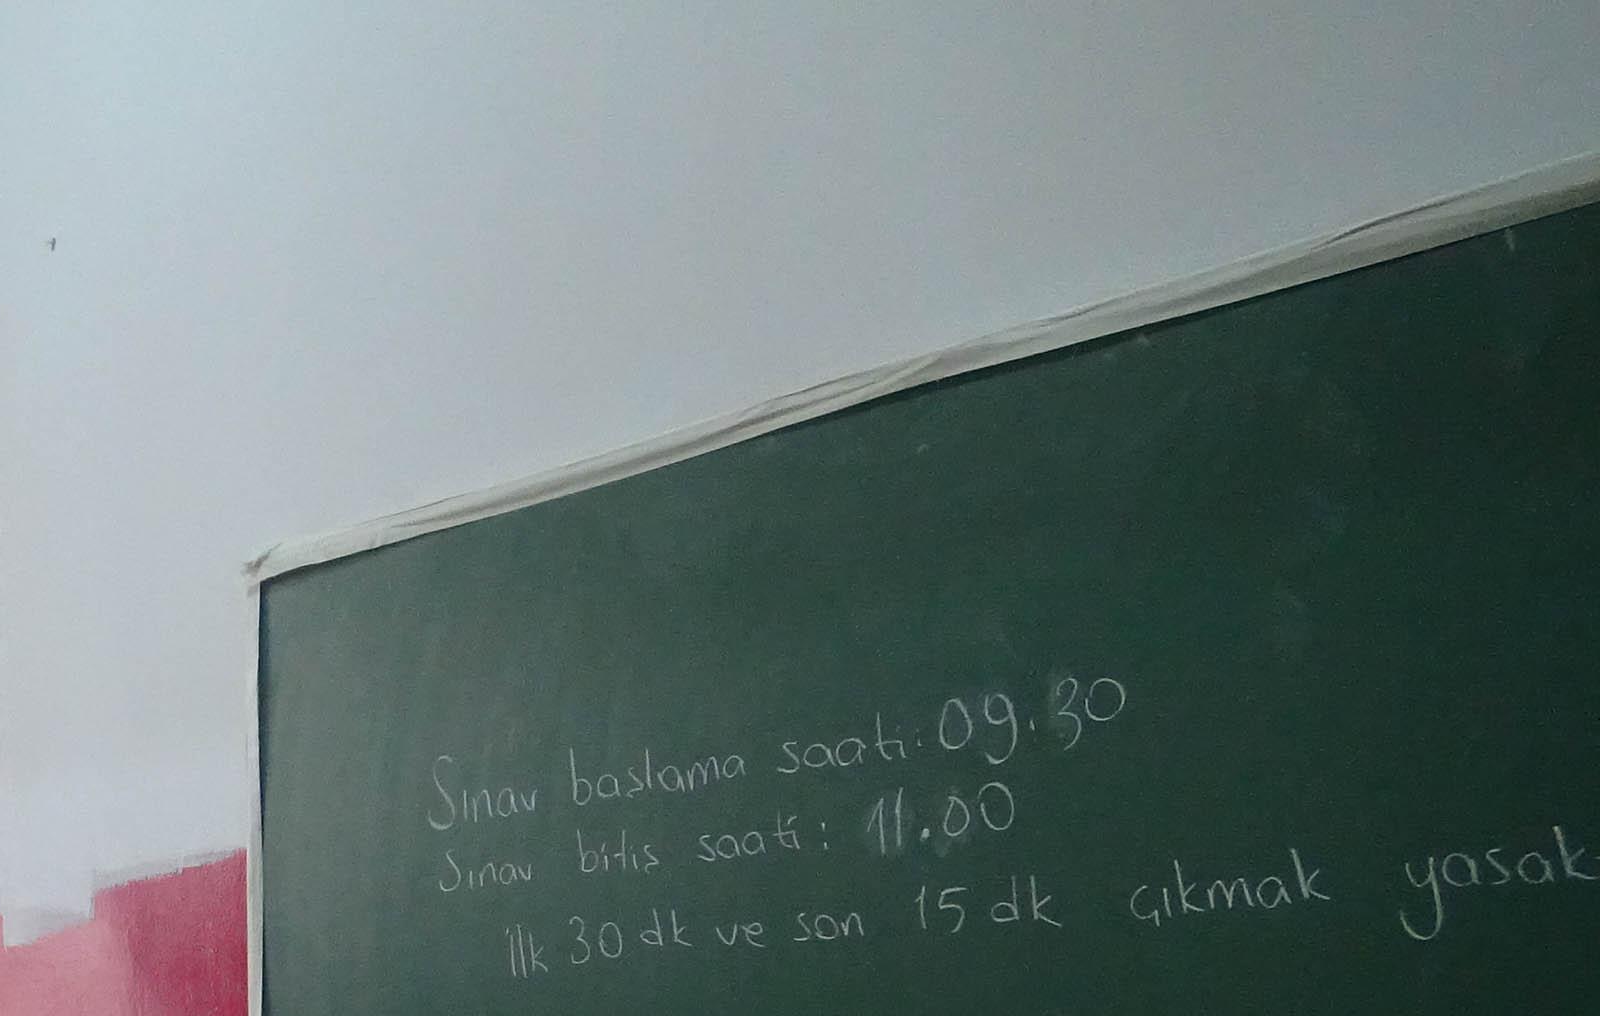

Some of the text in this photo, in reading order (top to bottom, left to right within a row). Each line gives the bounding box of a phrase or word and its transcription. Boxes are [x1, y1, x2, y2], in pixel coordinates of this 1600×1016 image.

[866, 782, 1015, 856] 11.00
[568, 915, 623, 964] 30
[639, 907, 692, 946] dk
[715, 922, 766, 947] ve
[793, 912, 864, 941] son
[915, 885, 968, 934] 15
[990, 875, 1062, 928] dk
[1400, 825, 1600, 941] yasak
